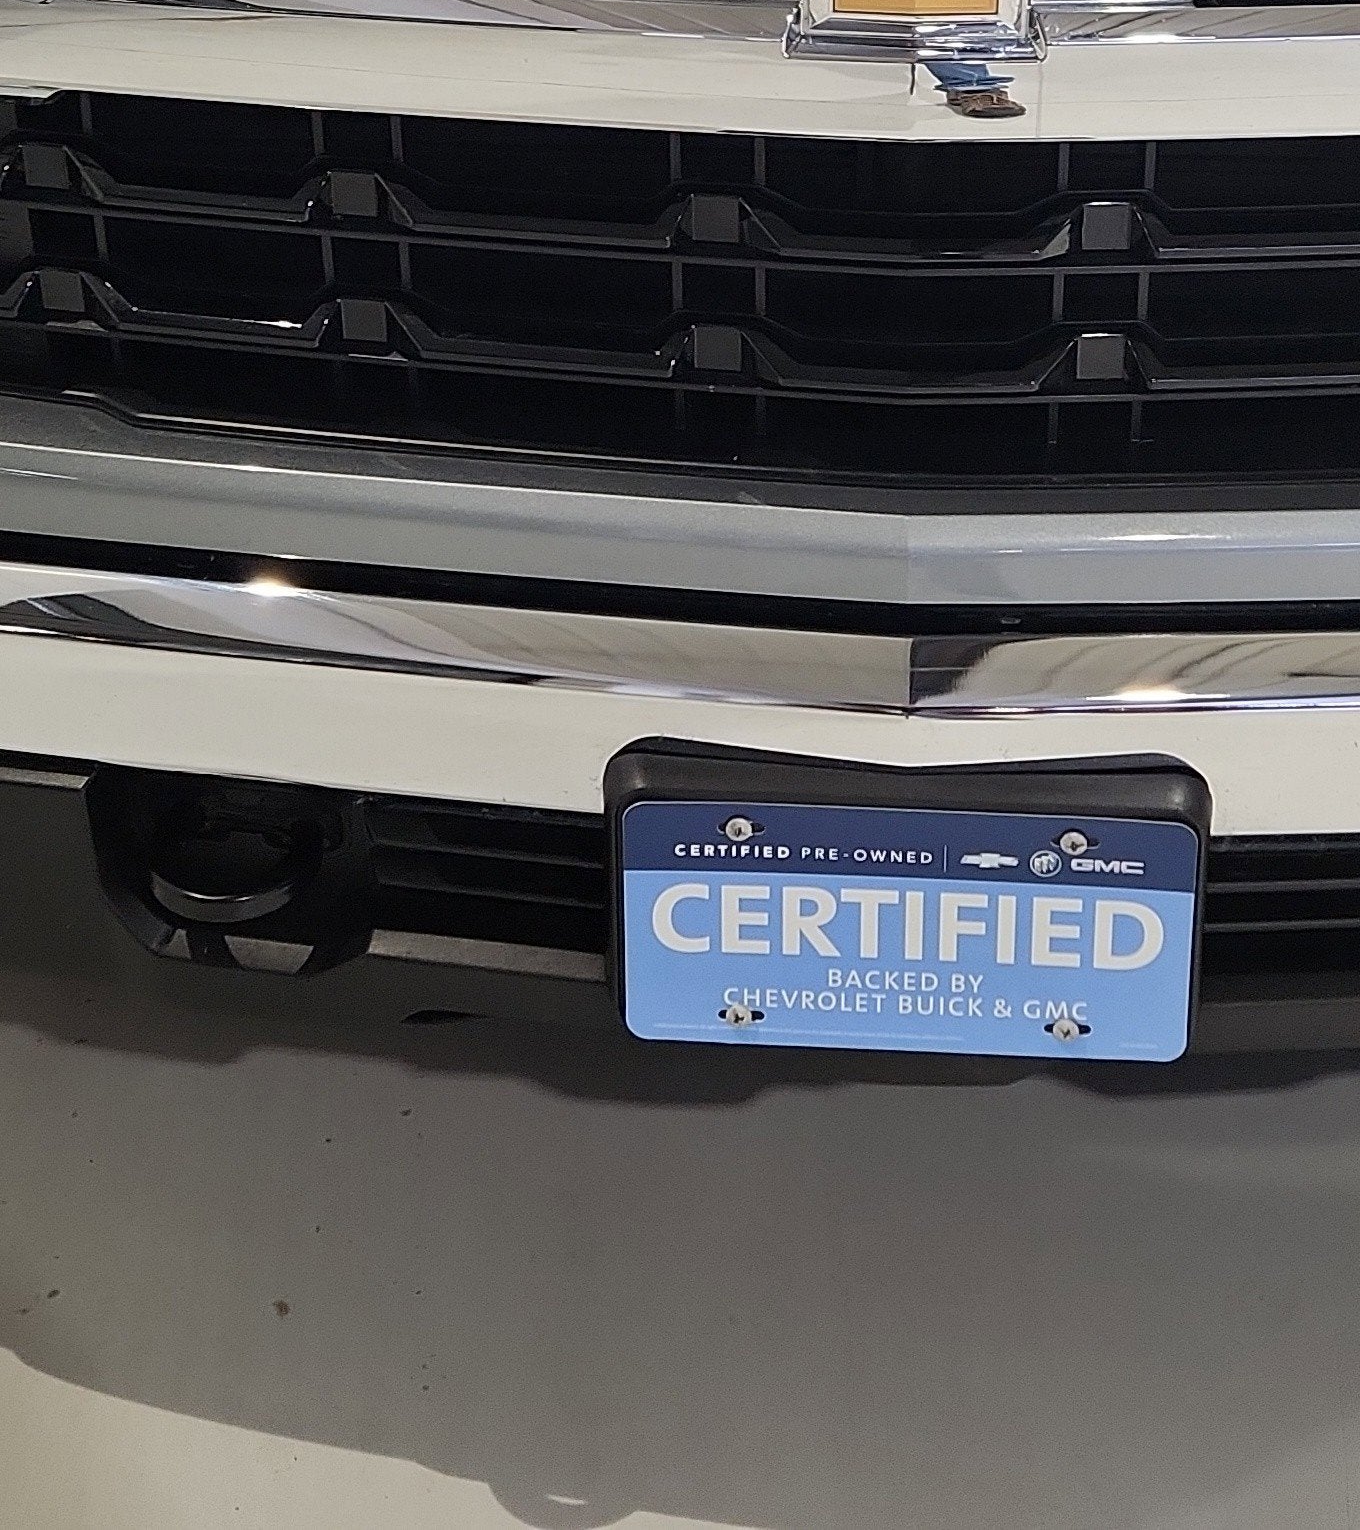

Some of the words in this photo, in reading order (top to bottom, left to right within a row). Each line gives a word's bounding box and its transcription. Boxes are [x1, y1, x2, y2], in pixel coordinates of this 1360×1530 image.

[673, 843, 791, 859] CERTIFIED
[800, 846, 934, 864] PRE-OWNED
[1070, 858, 1145, 875] GMC
[651, 882, 1165, 972] CERTIFIED
[827, 968, 939, 992] BACKED
[950, 974, 984, 994] BY
[723, 987, 887, 1014] CHEVROLET
[897, 995, 984, 1018] BUICK
[992, 998, 1012, 1018] &
[1022, 999, 1088, 1021] GMC
